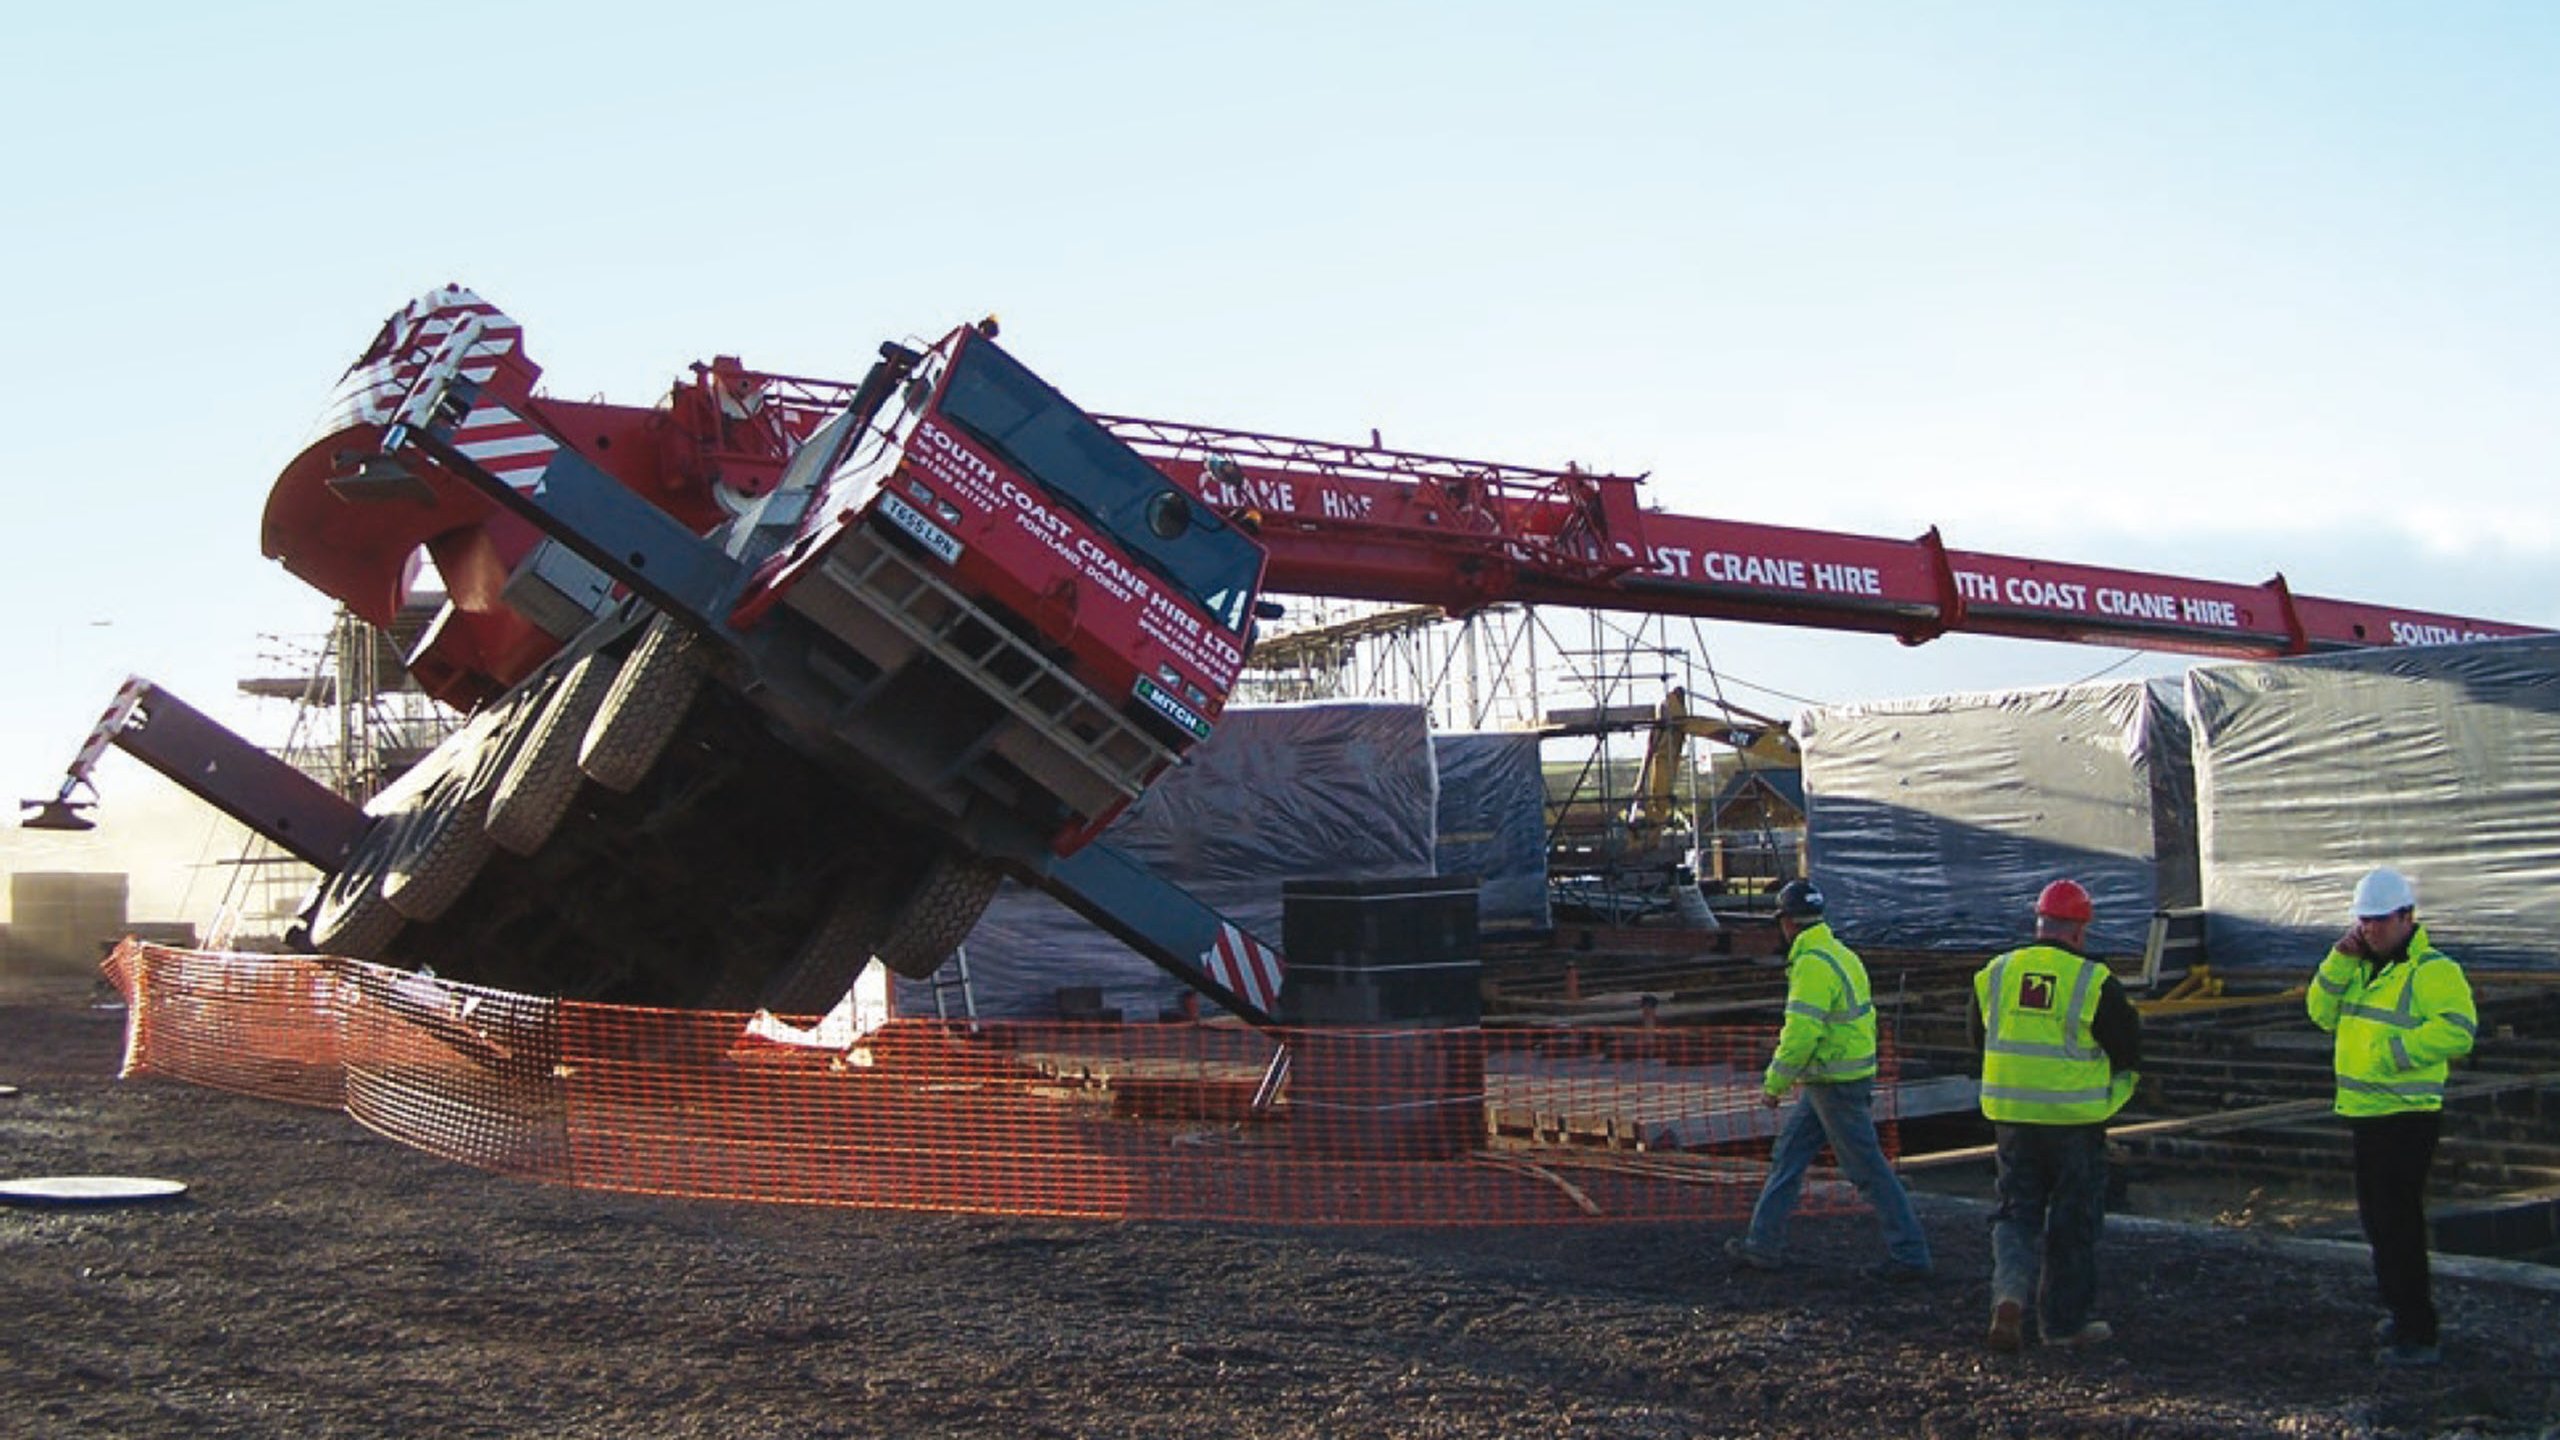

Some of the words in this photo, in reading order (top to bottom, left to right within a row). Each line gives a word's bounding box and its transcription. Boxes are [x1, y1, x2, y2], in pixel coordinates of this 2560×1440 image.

[919, 422, 996, 485] SOUTH
[1002, 482, 1073, 538] COAST
[1077, 538, 1149, 598] CRANE
[1150, 592, 1201, 637] HIRE
[1203, 631, 1241, 664] LTD
[1085, 564, 1132, 603] DORSET
[1704, 551, 1807, 589] CRANE
[1813, 563, 1882, 595] HIRE
[2005, 577, 2087, 610] COAST
[2096, 588, 2177, 621] CRANE
[2182, 597, 2238, 627] HIRE
[2390, 621, 2459, 646] SOUTH
[1150, 688, 1198, 729] MITCH
